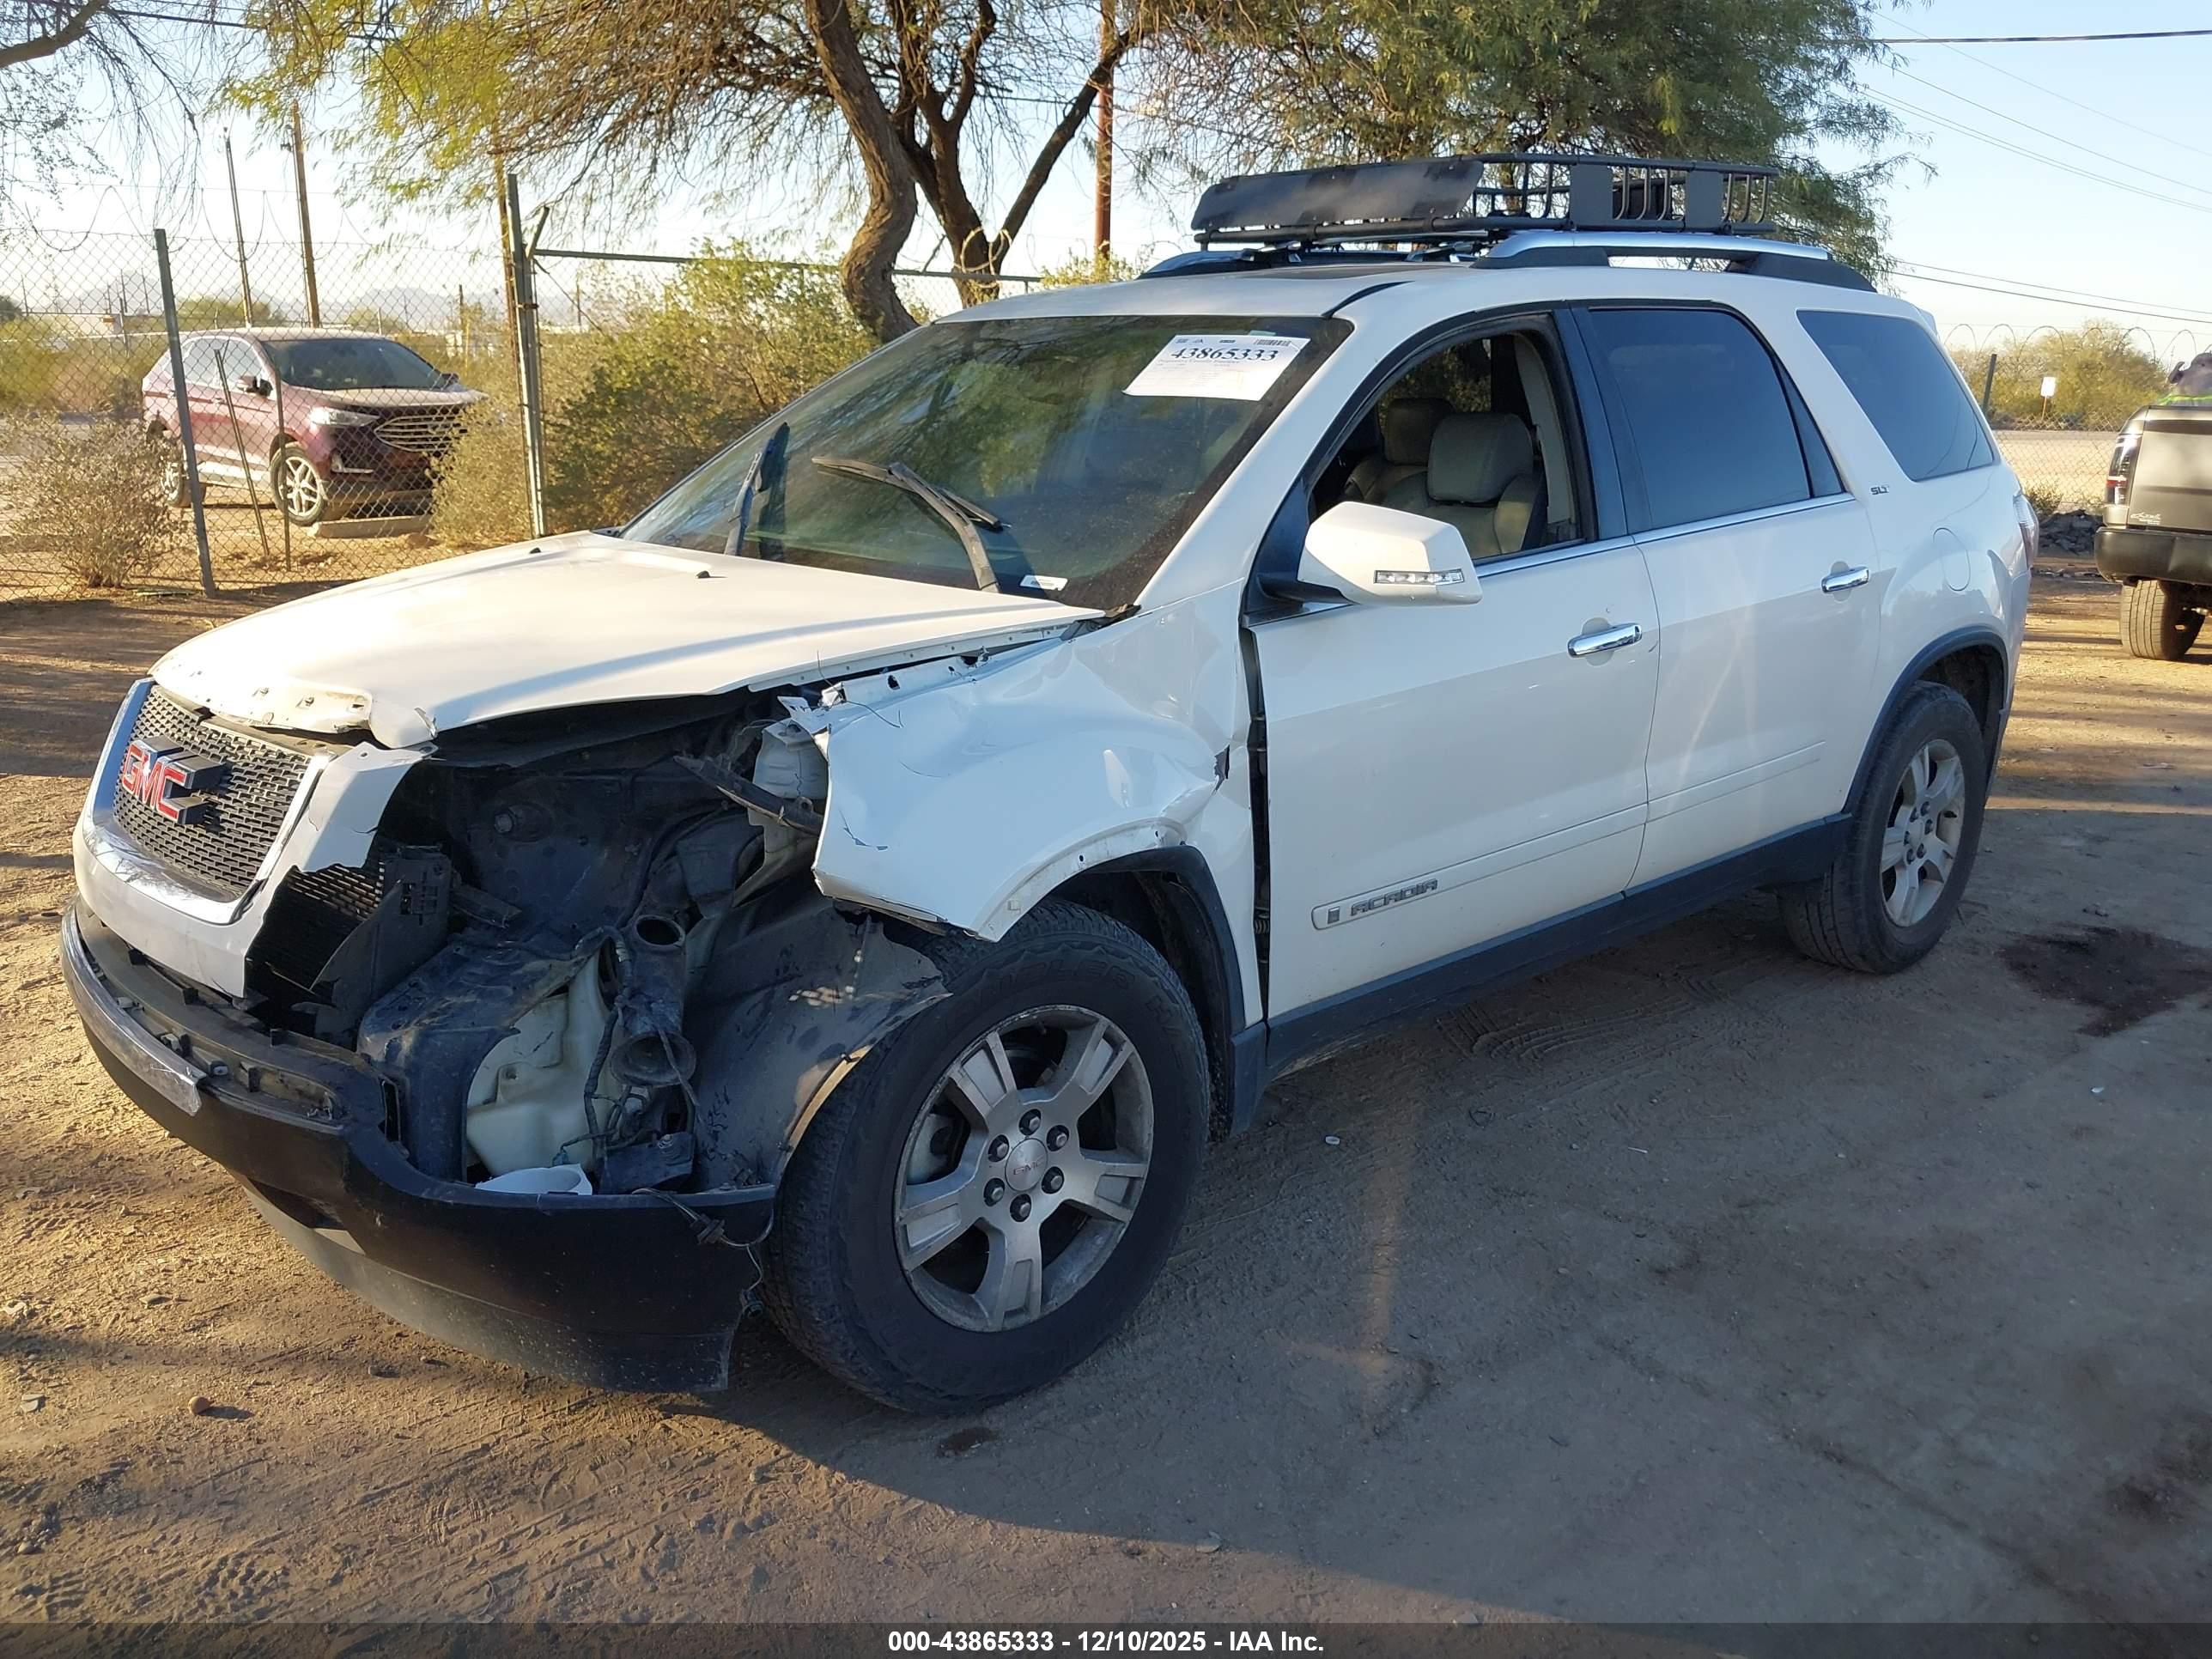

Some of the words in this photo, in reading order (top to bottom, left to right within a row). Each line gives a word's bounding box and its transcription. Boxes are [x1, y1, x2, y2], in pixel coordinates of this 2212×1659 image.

[1170, 348, 1279, 361] 43865333
[121, 739, 191, 824] GMC
[1350, 878, 1438, 916] ACADIA
[1012, 1154, 1044, 1176] GMC
